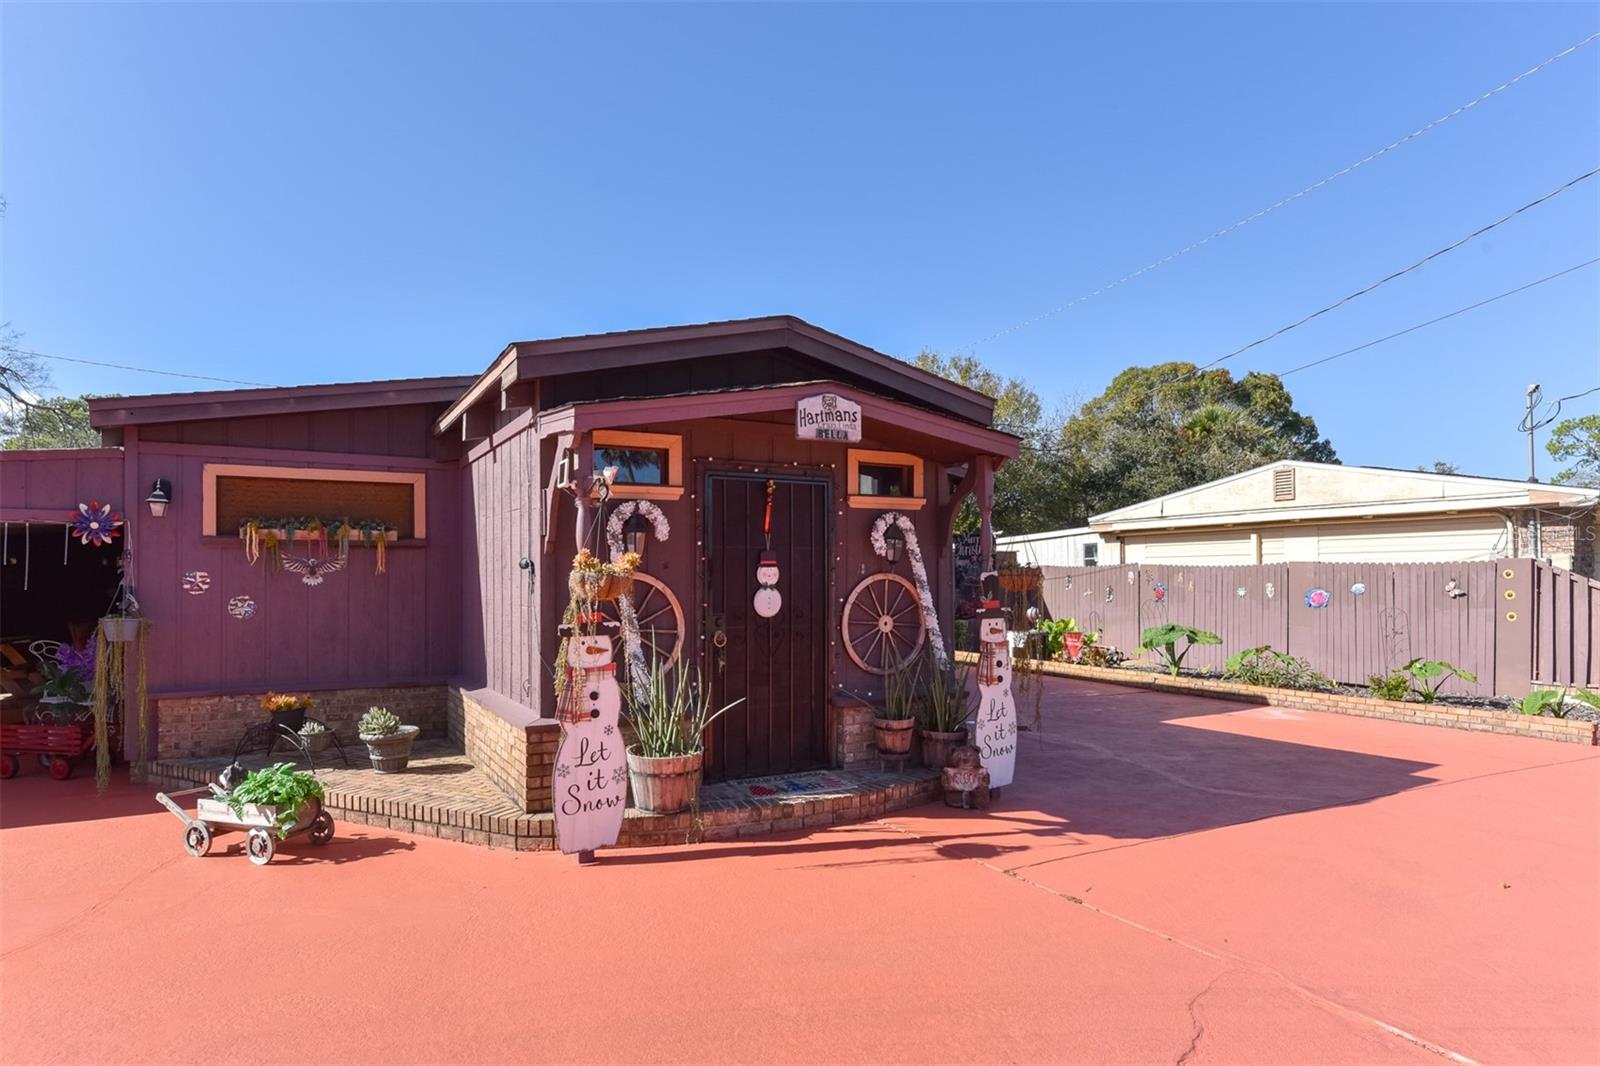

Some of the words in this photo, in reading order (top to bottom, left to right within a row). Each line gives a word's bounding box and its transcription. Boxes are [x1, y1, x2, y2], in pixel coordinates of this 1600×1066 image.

[799, 408, 858, 427] Hartmans
[986, 698, 1008, 722] Let
[994, 723, 1007, 741] it
[572, 737, 611, 768] Let
[980, 735, 1015, 759] Snow
[587, 769, 608, 791] it
[562, 784, 624, 816] Snow
